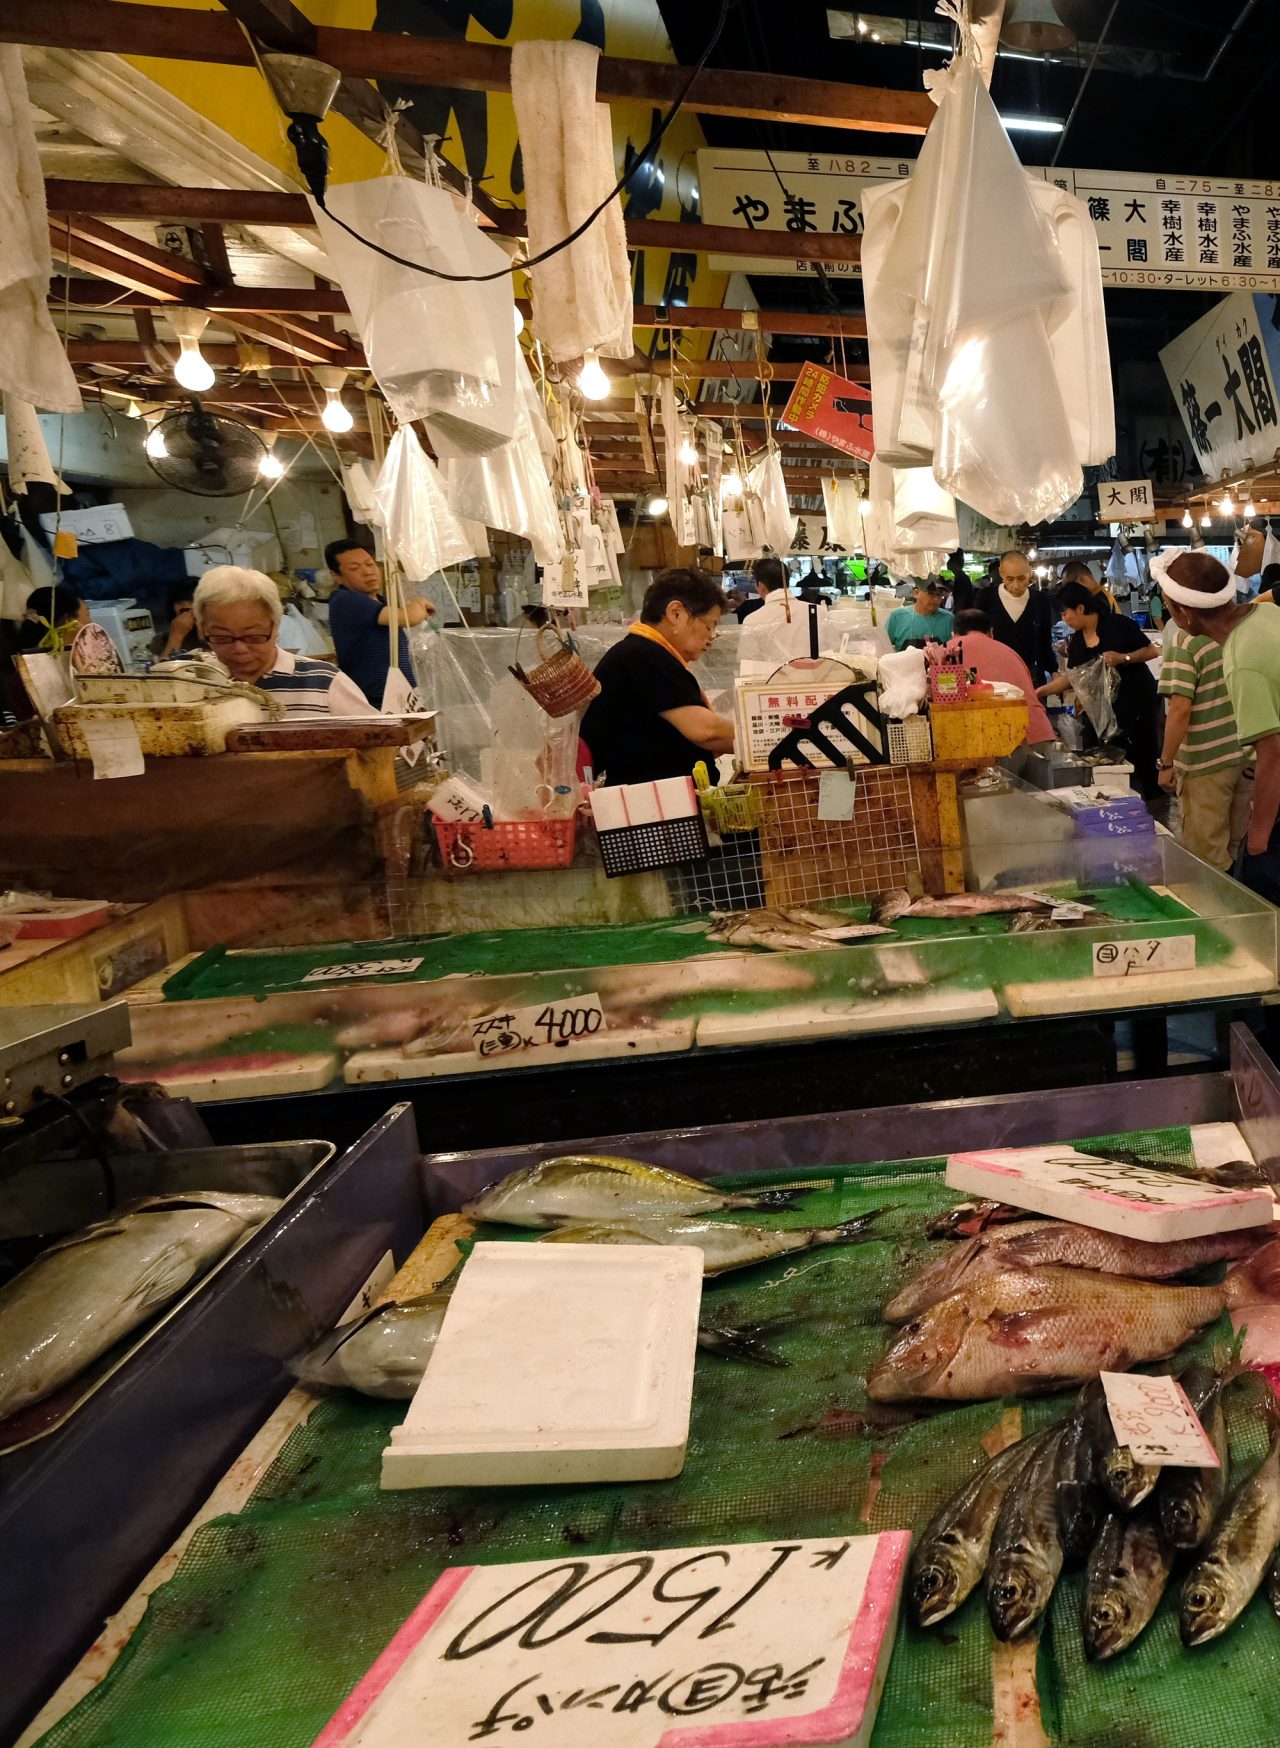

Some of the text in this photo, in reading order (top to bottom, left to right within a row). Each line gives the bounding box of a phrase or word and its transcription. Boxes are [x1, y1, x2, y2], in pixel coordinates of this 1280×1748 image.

[1161, 200, 1185, 262] 幸樹水産
[1197, 202, 1220, 264] 幸樹水産
[1231, 204, 1252, 268] やまふ水産
[535, 1006, 603, 1044] 4000
[441, 1546, 803, 1662] 1500
